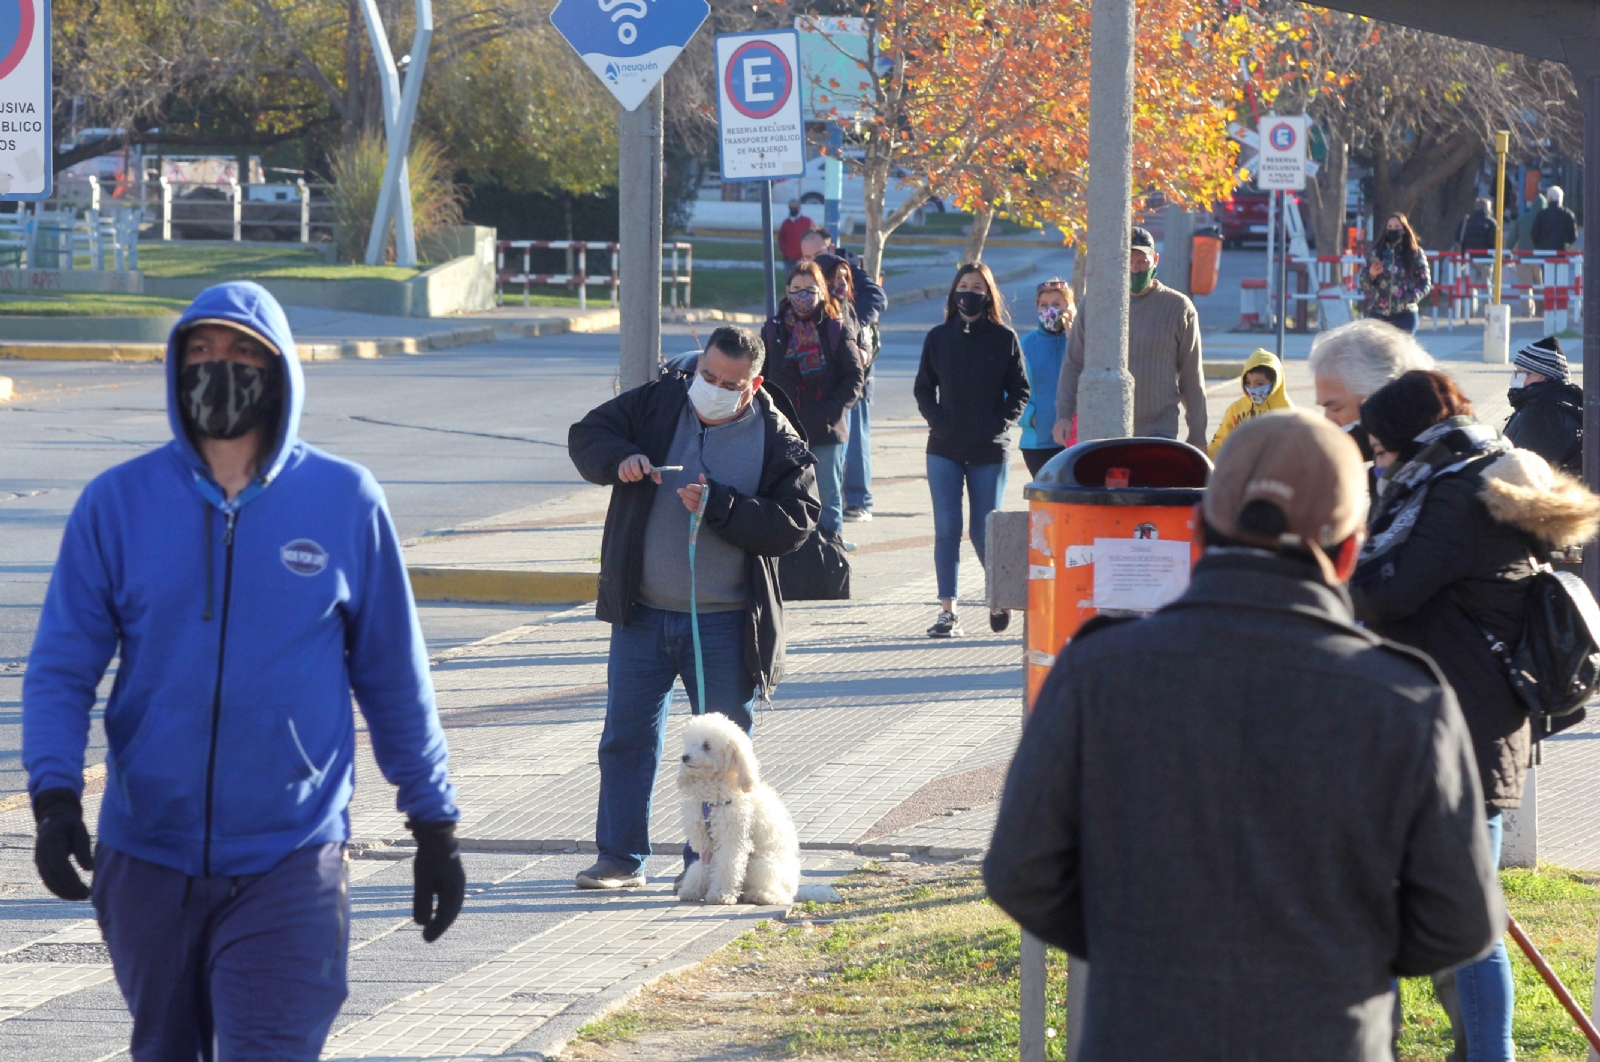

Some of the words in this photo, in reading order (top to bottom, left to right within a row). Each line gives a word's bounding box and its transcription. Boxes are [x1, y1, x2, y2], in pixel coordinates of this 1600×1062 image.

[621, 61, 658, 72] neuquén
[743, 56, 774, 102] E
[727, 126, 758, 135] RESERVA
[759, 124, 796, 133] EXCLUSIVA
[724, 136, 769, 145] TRANSPORTE
[1276, 128, 1289, 146] E
[737, 147, 747, 155] DE
[748, 145, 788, 154] PASAJEROS
